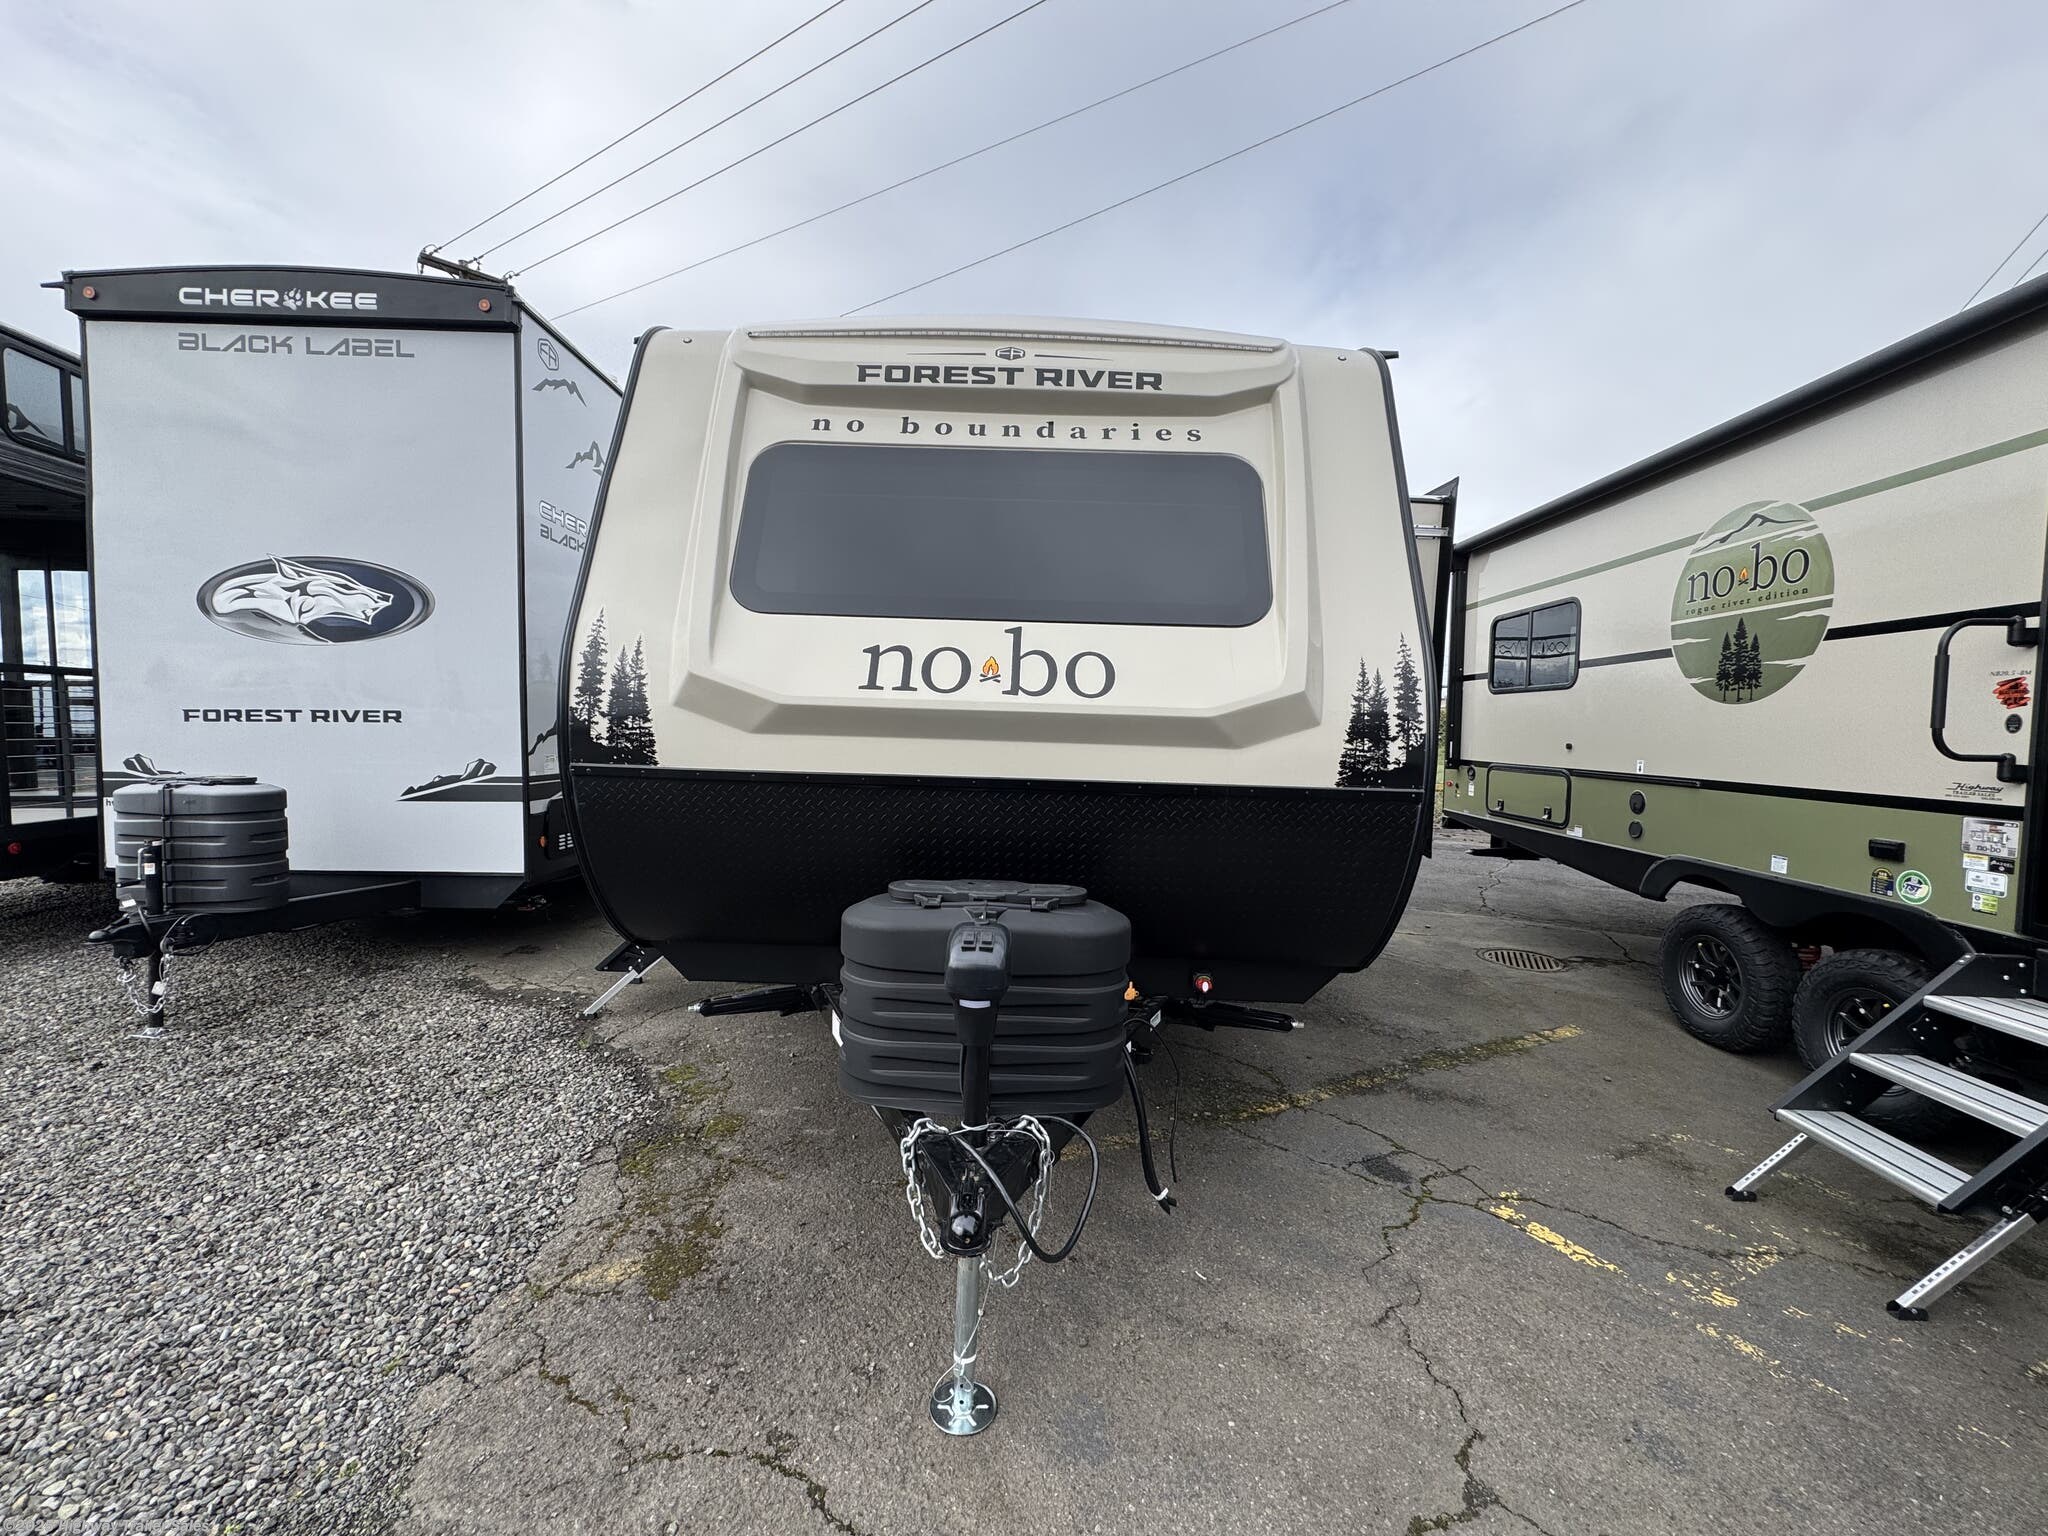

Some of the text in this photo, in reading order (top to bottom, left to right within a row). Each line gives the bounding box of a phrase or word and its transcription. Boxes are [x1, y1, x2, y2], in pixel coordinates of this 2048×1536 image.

[178, 332, 415, 358] BLACK LABEL
[857, 364, 1163, 391] FOREST RIVER
[811, 416, 1203, 443] no boundaries
[1685, 587, 1809, 616] rogue river edition
[183, 709, 402, 723] FOREST RIVER
[1952, 782, 2004, 794] Highway
[1904, 883, 1922, 893] TST
